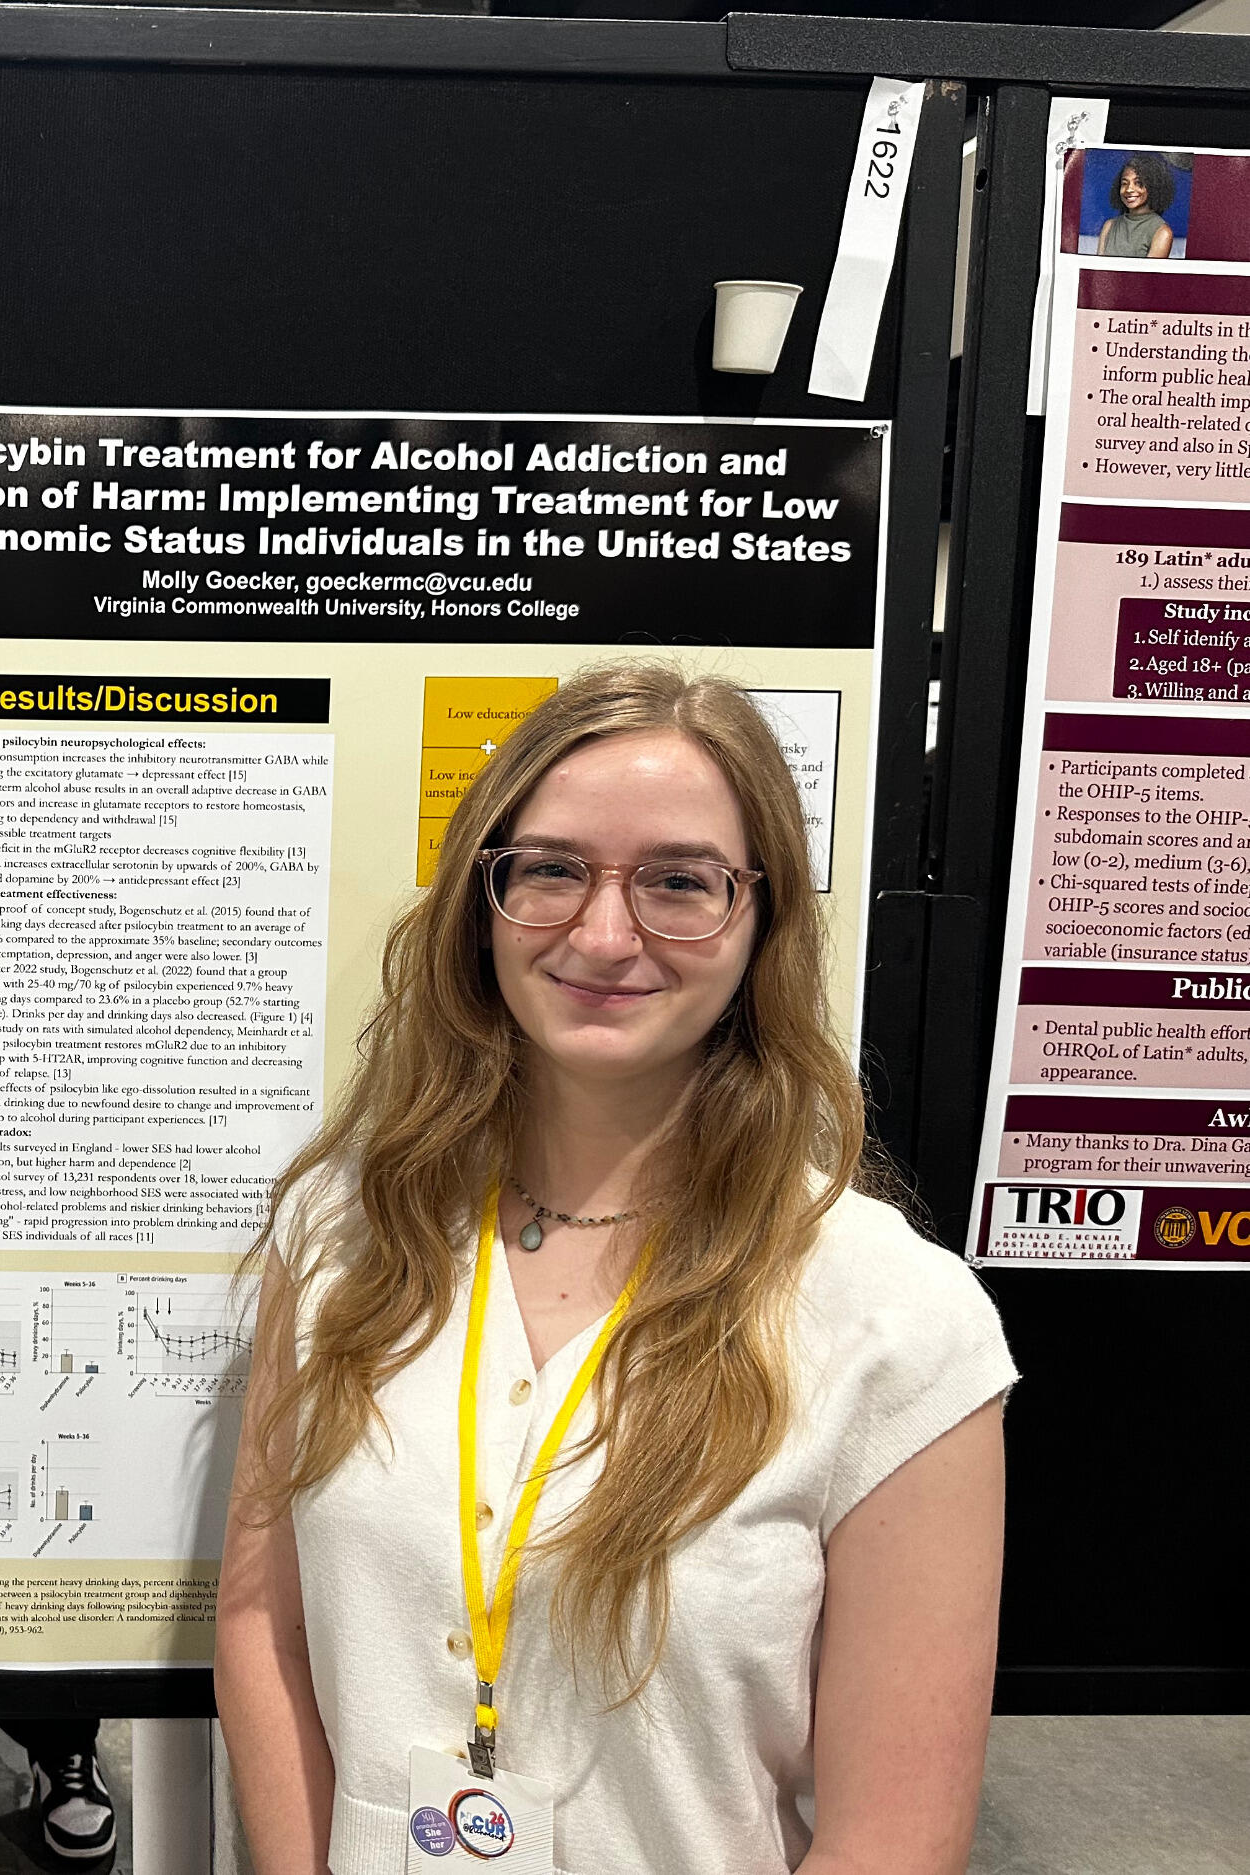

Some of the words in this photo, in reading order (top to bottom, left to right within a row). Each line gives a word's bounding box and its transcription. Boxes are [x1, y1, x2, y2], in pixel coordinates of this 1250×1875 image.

[864, 123, 901, 199] 1622
[1106, 341, 1228, 365] Understanding
[1232, 345, 1250, 362] th
[1099, 388, 1128, 405] The
[1131, 390, 1162, 406] oral
[1166, 390, 1216, 408] health
[98, 438, 296, 469] Treatment
[307, 440, 362, 469] for
[370, 441, 514, 471] Alcohol
[525, 443, 707, 473] Addiction
[719, 448, 787, 476] and
[1094, 457, 1170, 478] However,
[1176, 465, 1212, 480] very
[41, 480, 80, 509] of
[92, 481, 205, 511] Harm:
[219, 483, 479, 520] Implementing
[491, 485, 689, 516] Treatment
[699, 488, 752, 517] for
[762, 490, 839, 519] Low
[123, 525, 245, 554] Status
[258, 526, 464, 556] Individuals
[476, 528, 510, 556] in
[522, 528, 585, 557] the
[598, 529, 720, 559] United
[731, 532, 851, 562] States
[142, 569, 200, 594] Molly
[205, 570, 299, 593] Goecker,
[306, 571, 532, 595] goeckermc@vcu.edu
[93, 595, 166, 617] Virginia
[171, 596, 318, 615] Commonwealth
[325, 598, 425, 620] University,
[431, 599, 501, 616] Honors
[507, 599, 579, 621] College
[1164, 603, 1220, 623] Study
[448, 708, 474, 719] Low
[2, 736, 57, 749] psilocybin
[60, 737, 164, 750] neuropsychological
[167, 738, 206, 749] effects:
[1058, 781, 1083, 798] the
[1087, 783, 1150, 803] OHIP-5
[1155, 784, 1204, 801] items.
[29, 830, 76, 839] treatment
[79, 831, 112, 841] targets
[1052, 850, 1080, 866] low
[1084, 851, 1129, 871] (0-2),
[1134, 853, 1202, 870] medium
[1027, 1133, 1071, 1152] Many
[1076, 1135, 1129, 1150] thanks
[1133, 1138, 1149, 1151] to
[1153, 1137, 1185, 1152] Dra.
[1191, 1137, 1227, 1152] Dina
[1008, 1188, 1126, 1226] TRIO
[425, 1828, 442, 1838] She
[430, 1841, 445, 1850] her
